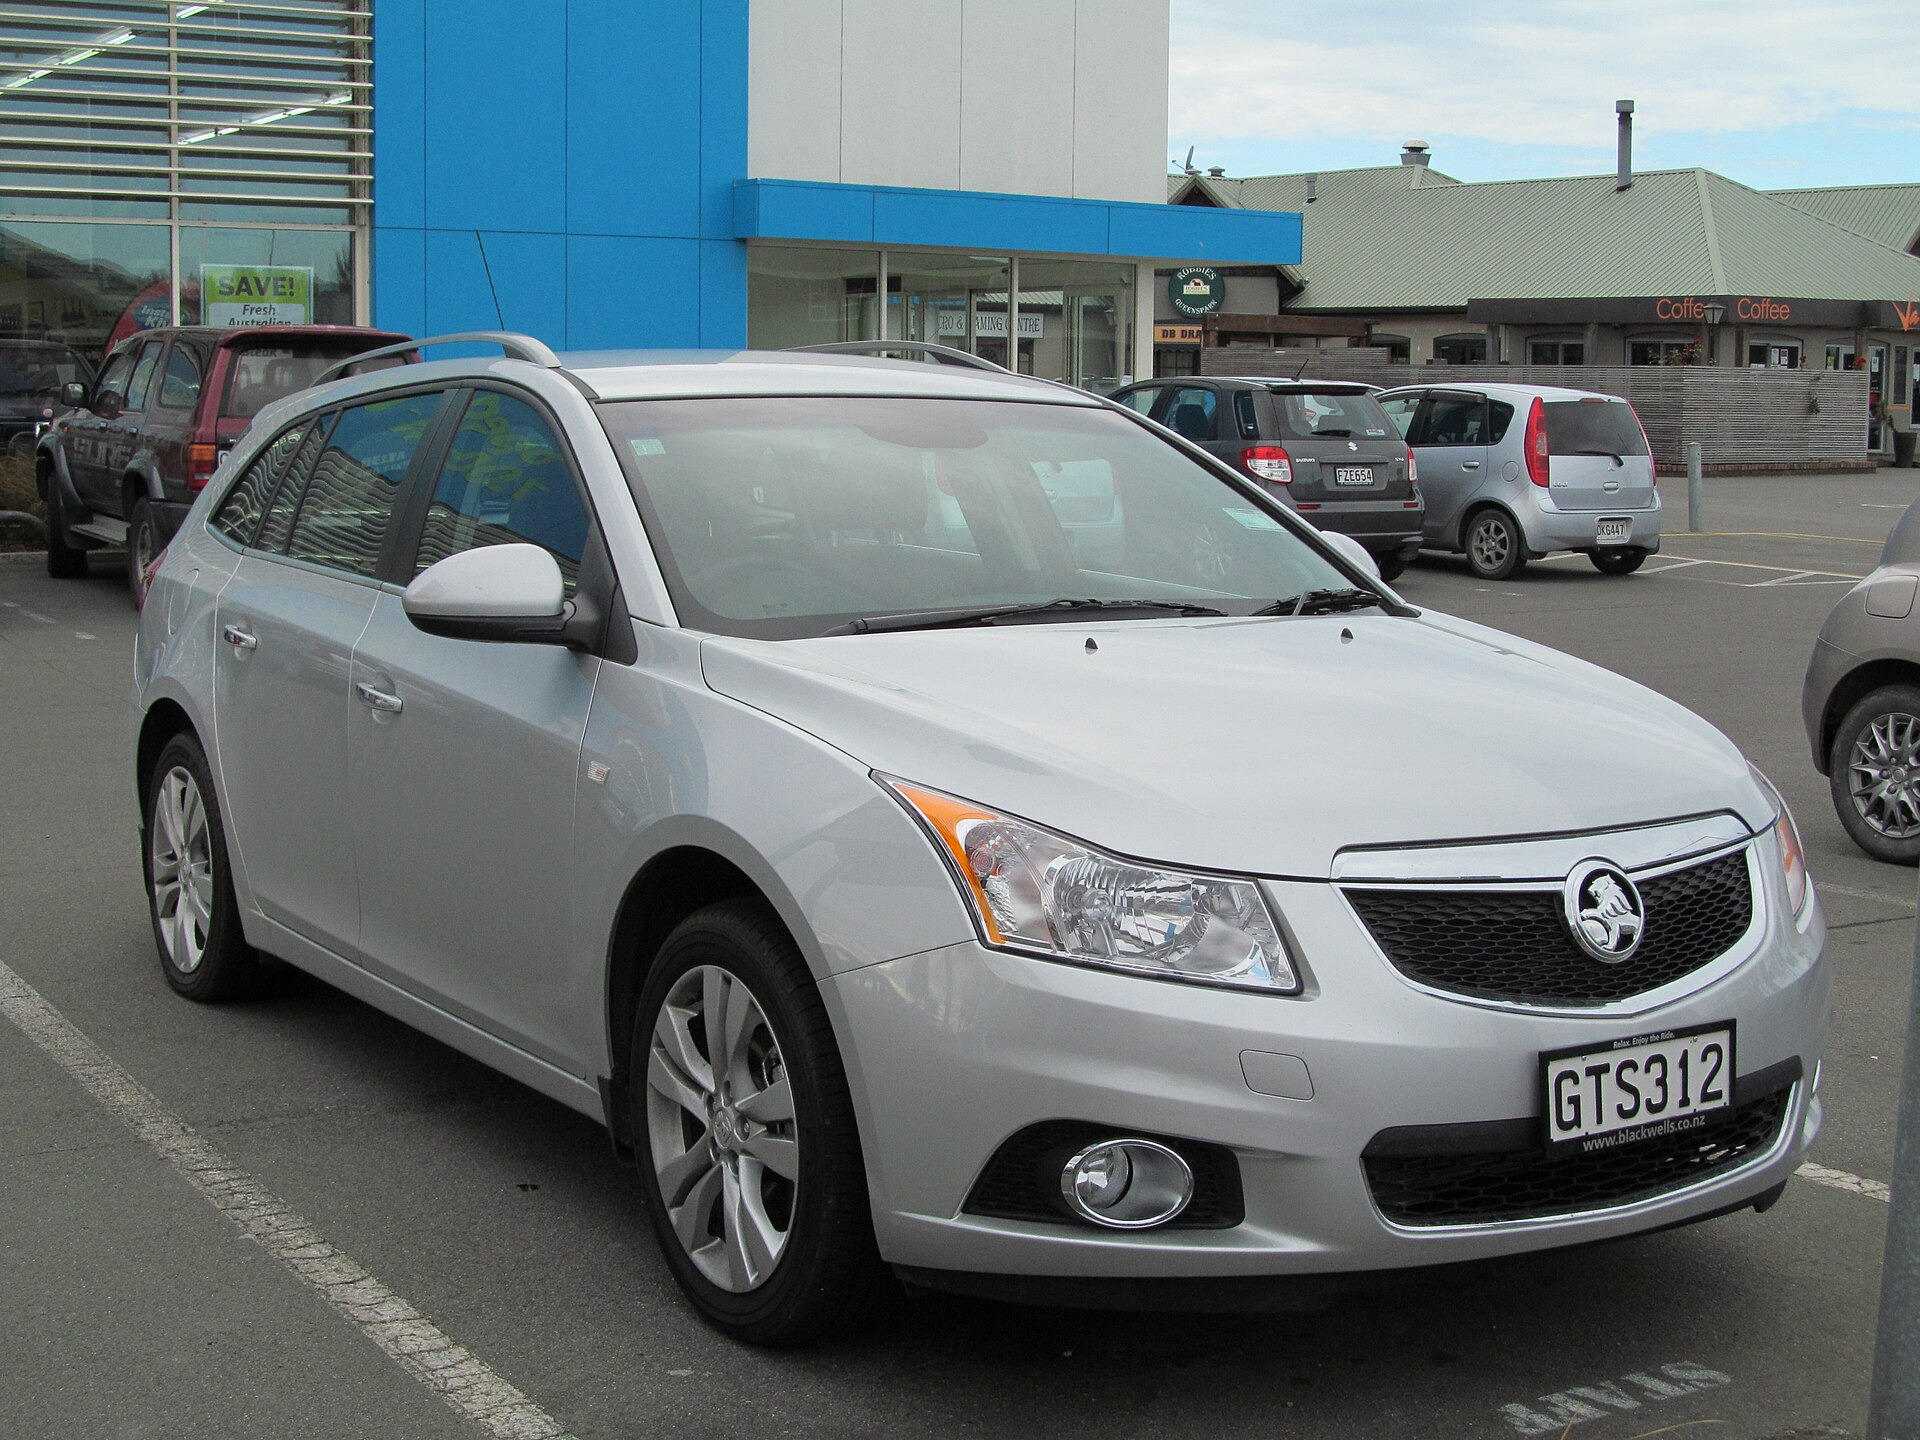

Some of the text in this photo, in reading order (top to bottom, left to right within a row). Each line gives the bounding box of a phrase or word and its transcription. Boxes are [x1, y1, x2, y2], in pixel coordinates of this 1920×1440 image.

[219, 275, 295, 297] SAVE!
[242, 304, 276, 316] Fresh
[1175, 298, 1218, 315] QUEENSPARK
[1656, 297, 1704, 319] Coffe
[1737, 297, 1790, 320] Coffee
[1162, 329, 1176, 339] DB
[1337, 469, 1372, 482] FZE654
[1613, 1030, 1675, 1049] Relax. Enjoy the Ride.
[1554, 1042, 1723, 1132] GTS312
[1583, 1114, 1706, 1152] www.blackwells.co.nz
